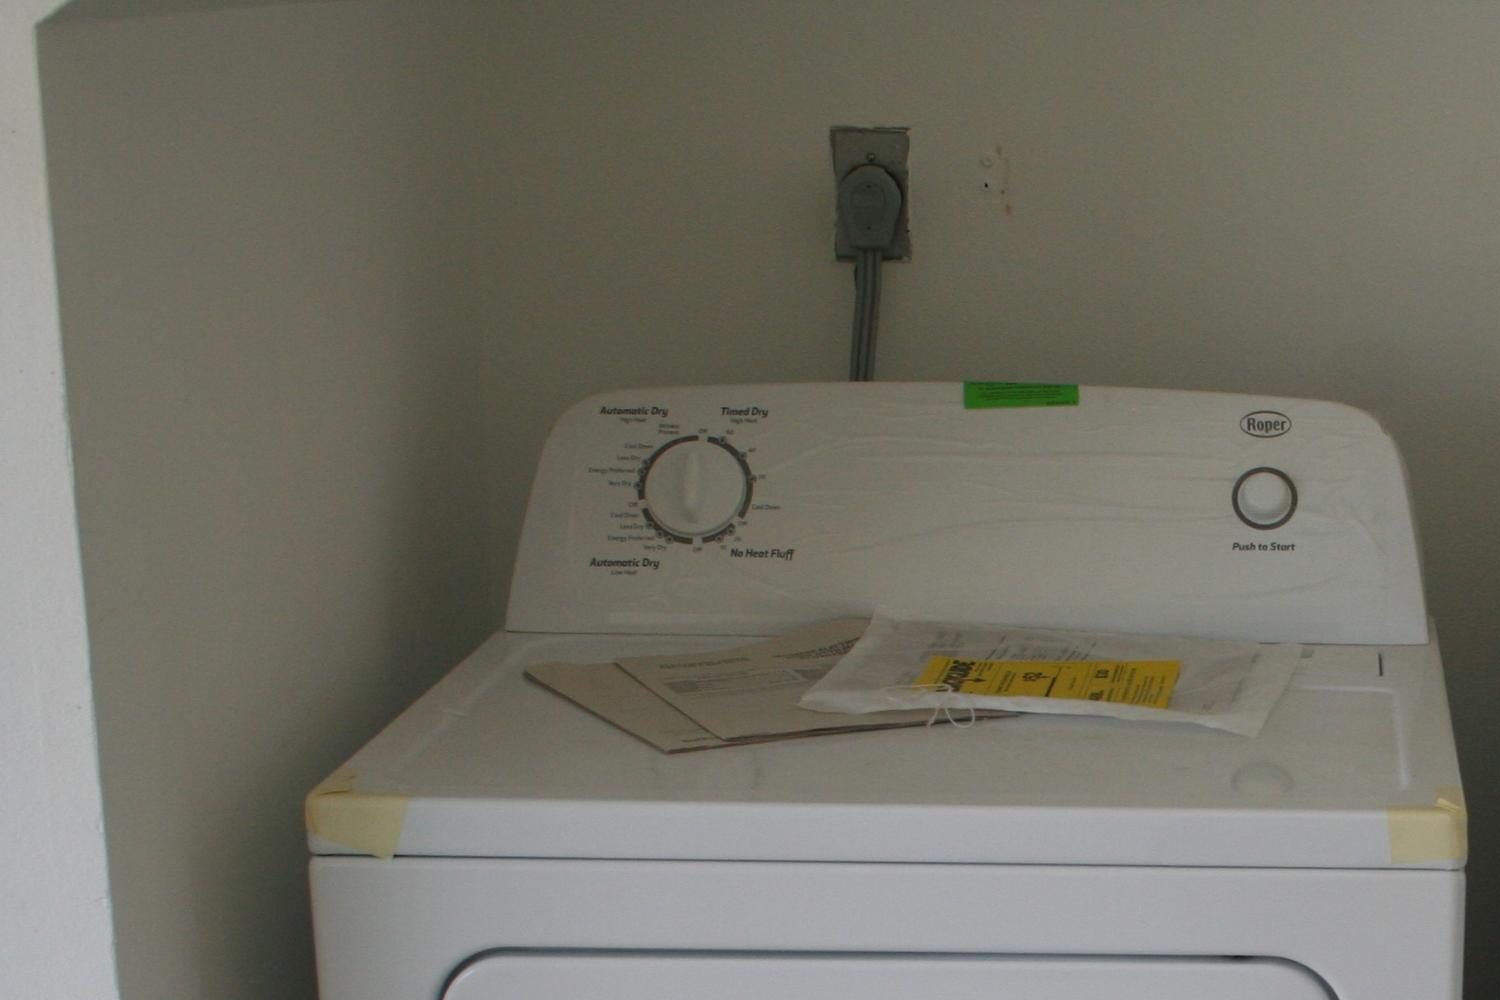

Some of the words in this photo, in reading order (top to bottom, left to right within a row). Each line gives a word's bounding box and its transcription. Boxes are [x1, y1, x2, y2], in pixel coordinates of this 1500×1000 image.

[600, 406, 649, 416] Automatic
[651, 406, 669, 418] Dry
[721, 407, 750, 416] Timed
[751, 407, 768, 418] Dry
[1247, 417, 1286, 433] Roper
[1232, 542, 1256, 551] Push
[1258, 543, 1268, 551] to
[1270, 543, 1295, 551] Start
[730, 549, 743, 558] No
[745, 549, 768, 558] Heat
[770, 549, 794, 561] Fluff
[590, 557, 640, 567] Automatic
[642, 558, 660, 570] Dry
